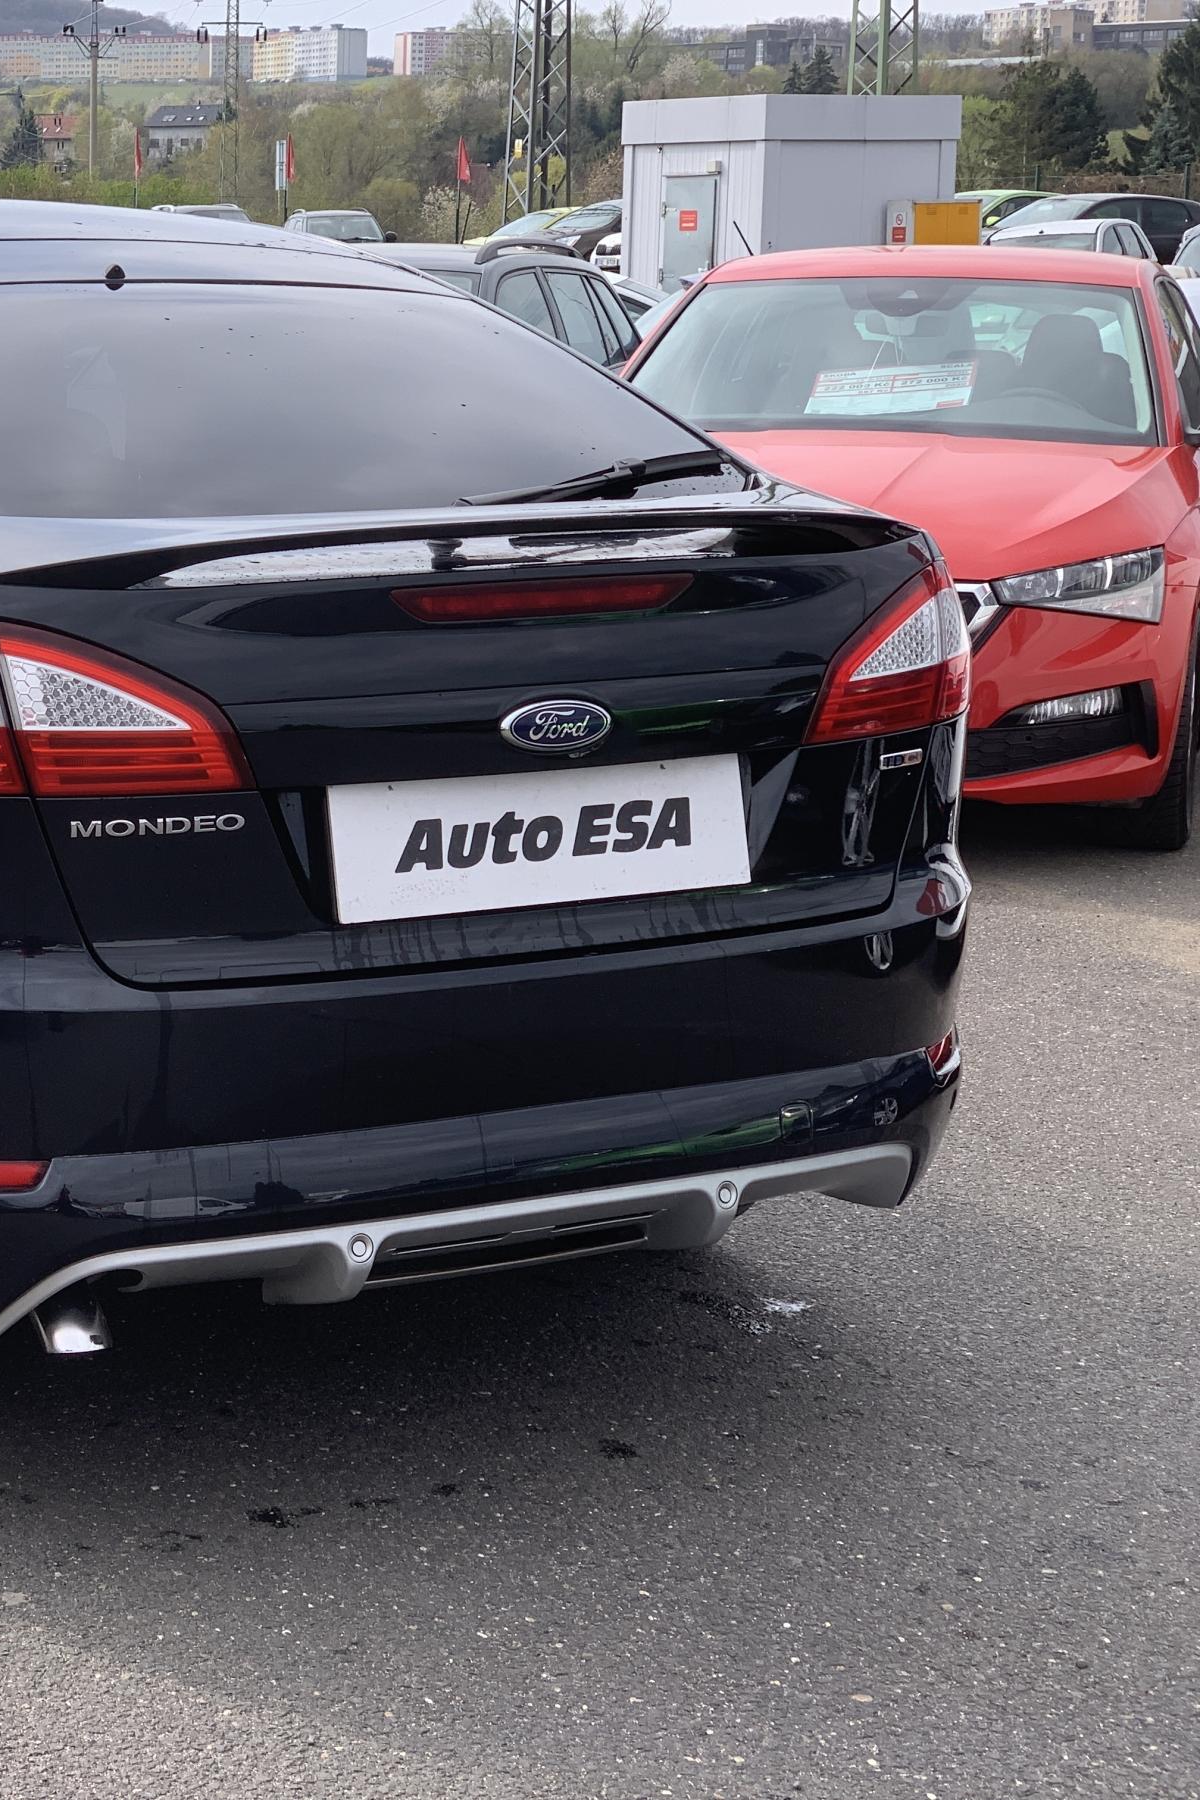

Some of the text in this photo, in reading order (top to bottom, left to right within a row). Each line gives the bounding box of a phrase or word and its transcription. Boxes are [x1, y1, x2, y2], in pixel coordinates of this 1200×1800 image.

[529, 709, 590, 741] Ford
[70, 813, 245, 838] MONDEO
[395, 797, 691, 873] Auto ESA
